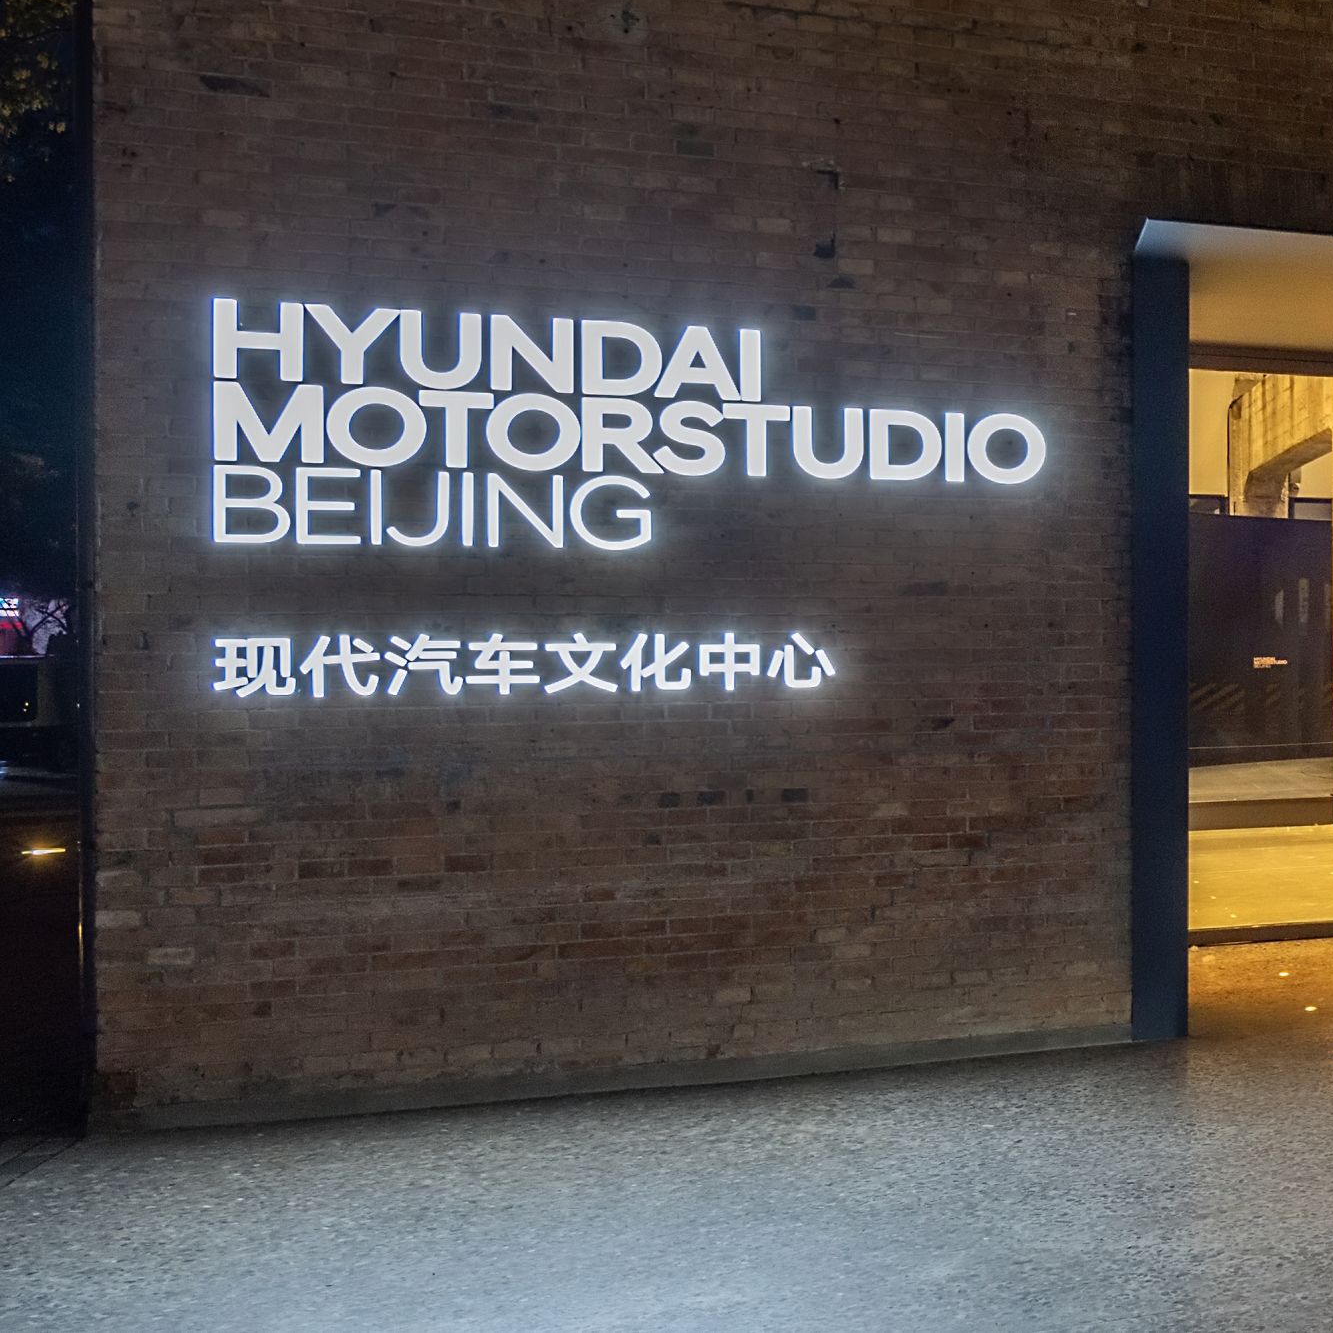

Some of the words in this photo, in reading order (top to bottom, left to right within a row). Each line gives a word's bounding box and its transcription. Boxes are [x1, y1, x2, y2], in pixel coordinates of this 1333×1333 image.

[212, 297, 762, 402] HYUNDAI
[212, 380, 1047, 485] MOTORSTUDIO
[212, 464, 652, 550] BEIJING
[212, 631, 837, 698] 现代汽车文化中心
